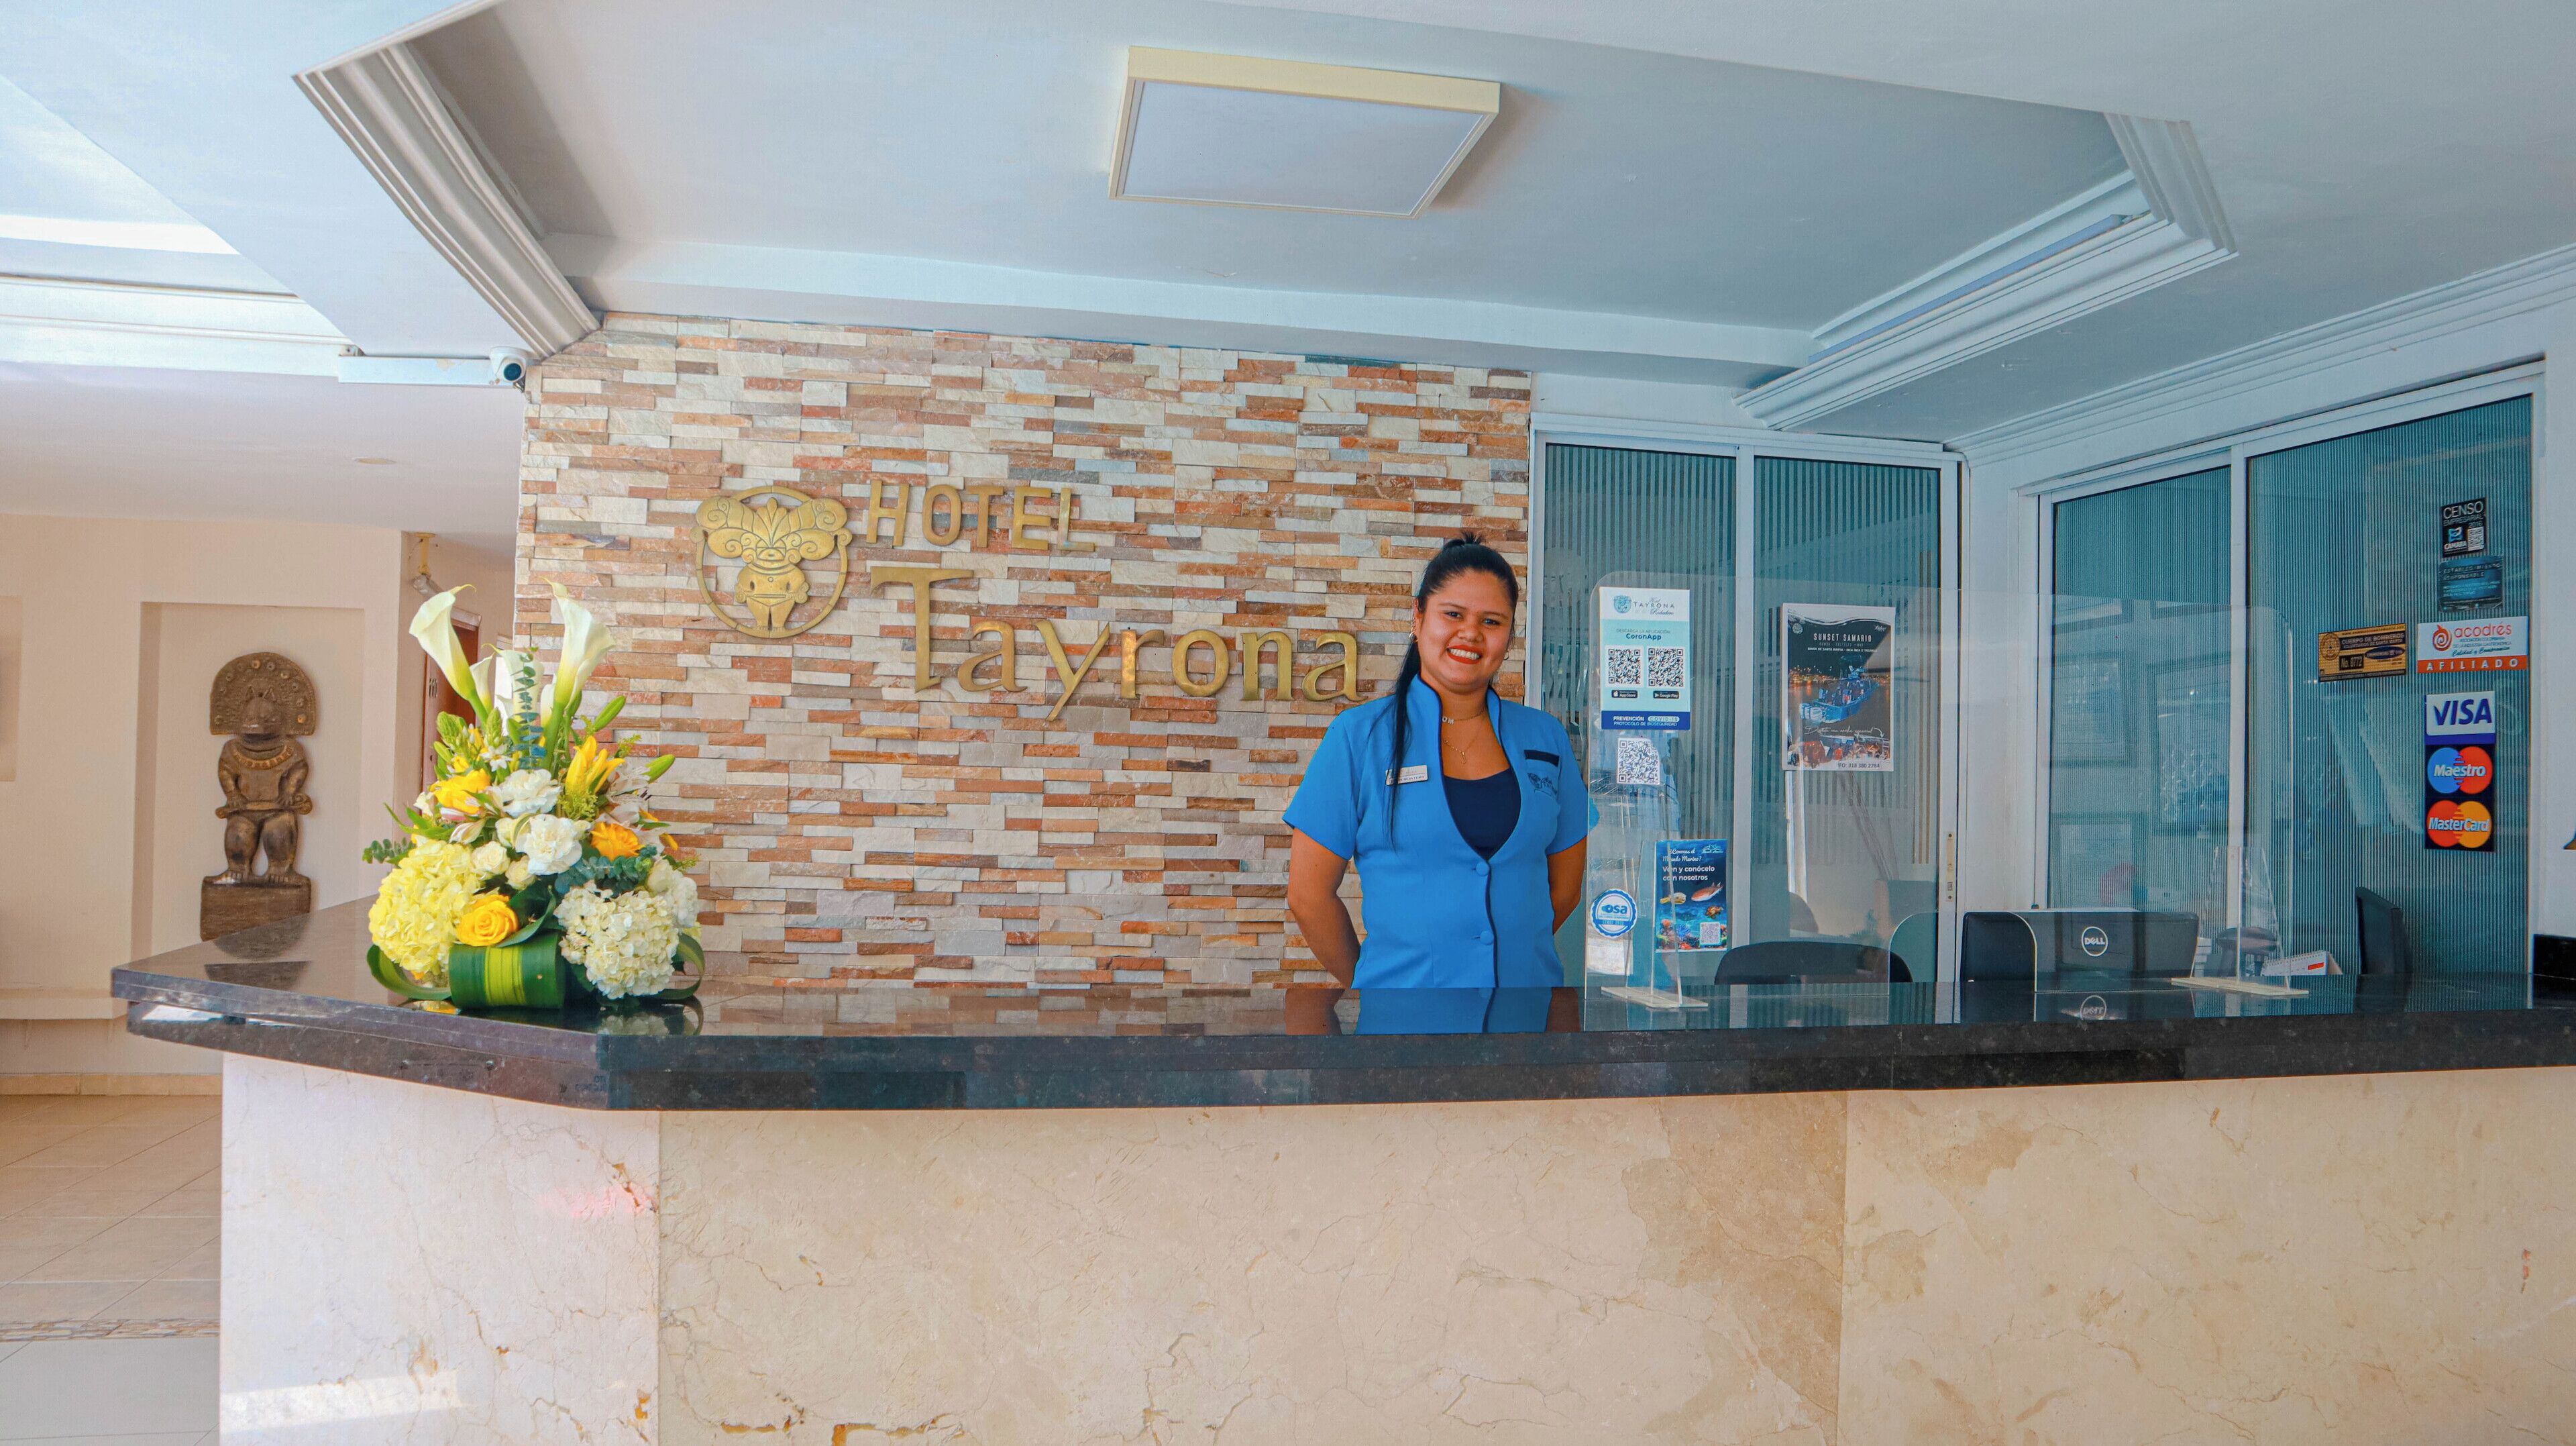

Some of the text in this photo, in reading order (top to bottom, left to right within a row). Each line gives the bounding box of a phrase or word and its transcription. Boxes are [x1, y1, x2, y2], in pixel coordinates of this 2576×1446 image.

[865, 479, 1097, 553] HOTEL
[2443, 501, 2483, 519] CENSO
[2454, 621, 2512, 637] acodrés
[869, 566, 1363, 721] Tayrona
[1843, 634, 1872, 642] SAMARIO
[2341, 637, 2363, 645] CUERPO
[2426, 658, 2518, 670] AFILIADO
[2433, 699, 2493, 726] VISA
[2434, 764, 2486, 777] Maestro
[2428, 817, 2491, 832] MasterCard
[2084, 937, 2105, 945] DELL
